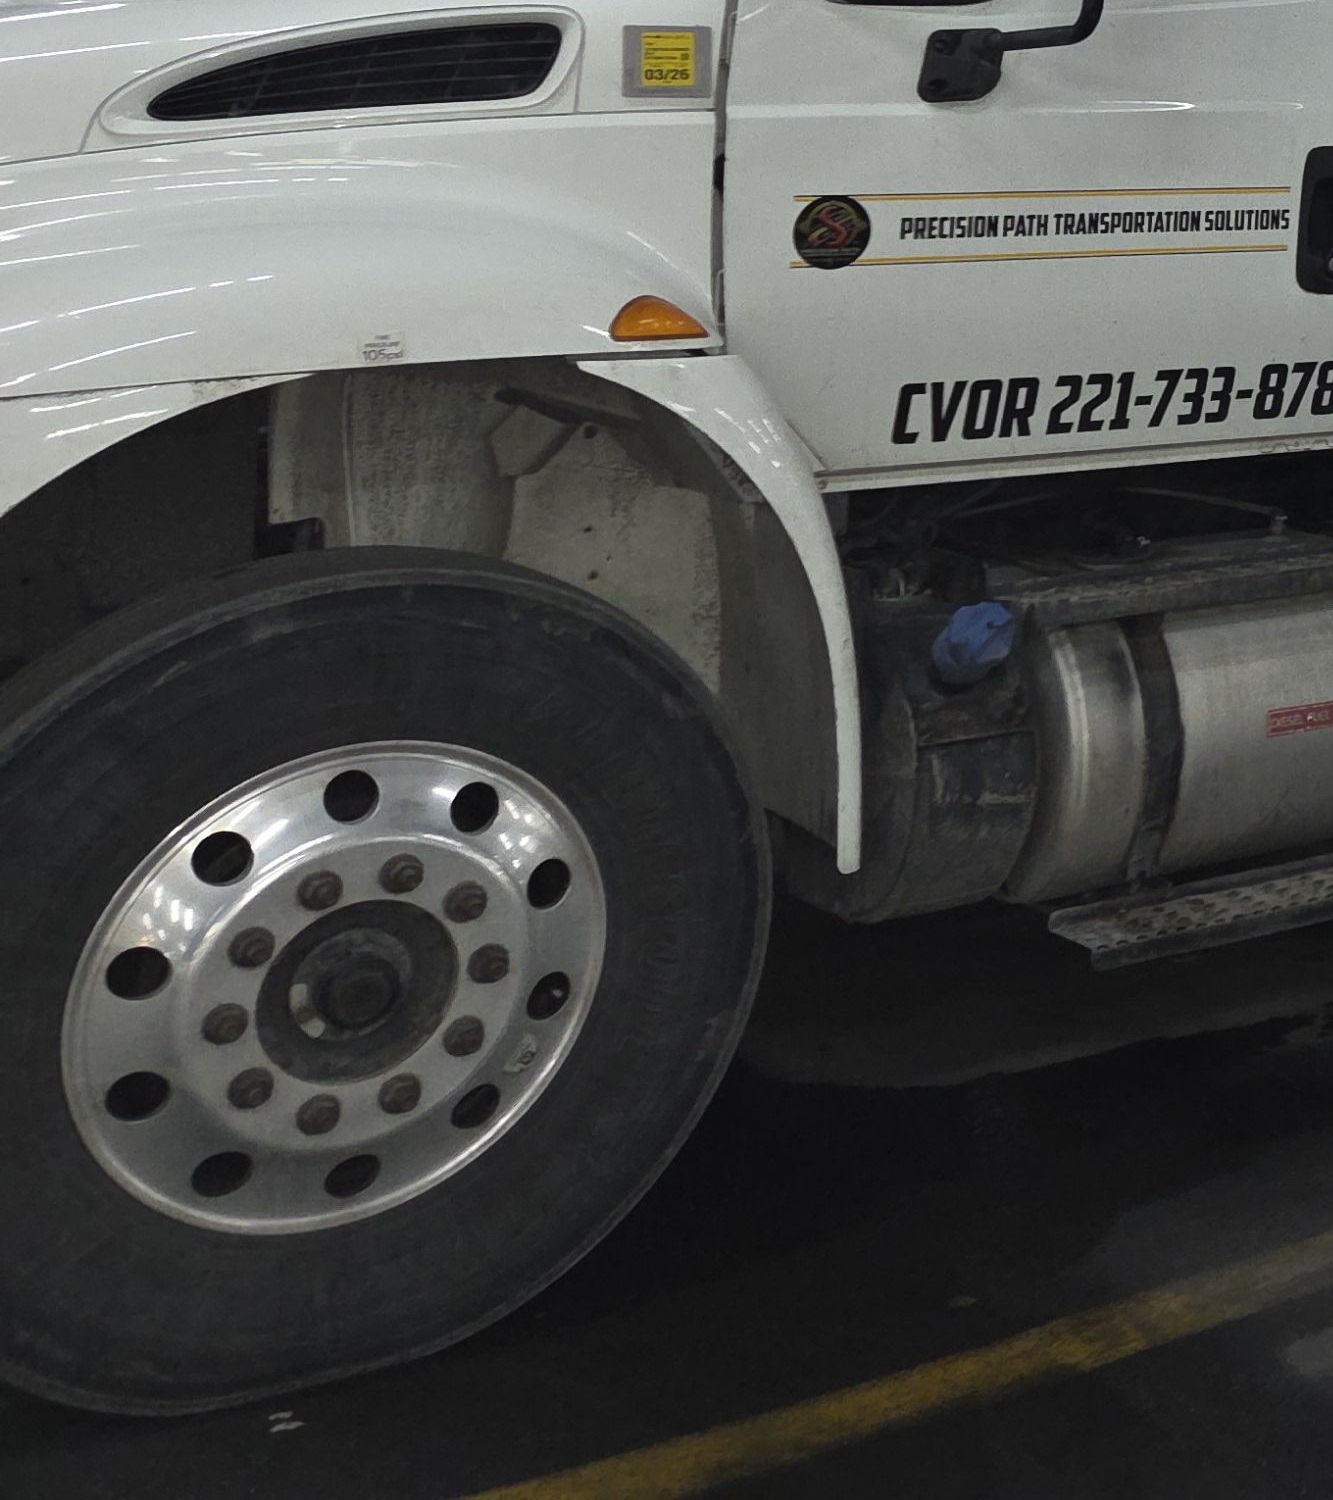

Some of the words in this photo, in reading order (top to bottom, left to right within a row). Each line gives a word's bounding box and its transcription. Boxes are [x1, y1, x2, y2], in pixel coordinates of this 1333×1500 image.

[644, 68, 690, 81] 03/26
[900, 215, 1000, 240] PRECISION
[1002, 213, 1048, 237] PATH
[1054, 210, 1201, 236] TRANSPORTATION
[1204, 209, 1290, 231] SOLUTIONS
[891, 377, 1040, 444] CVOR
